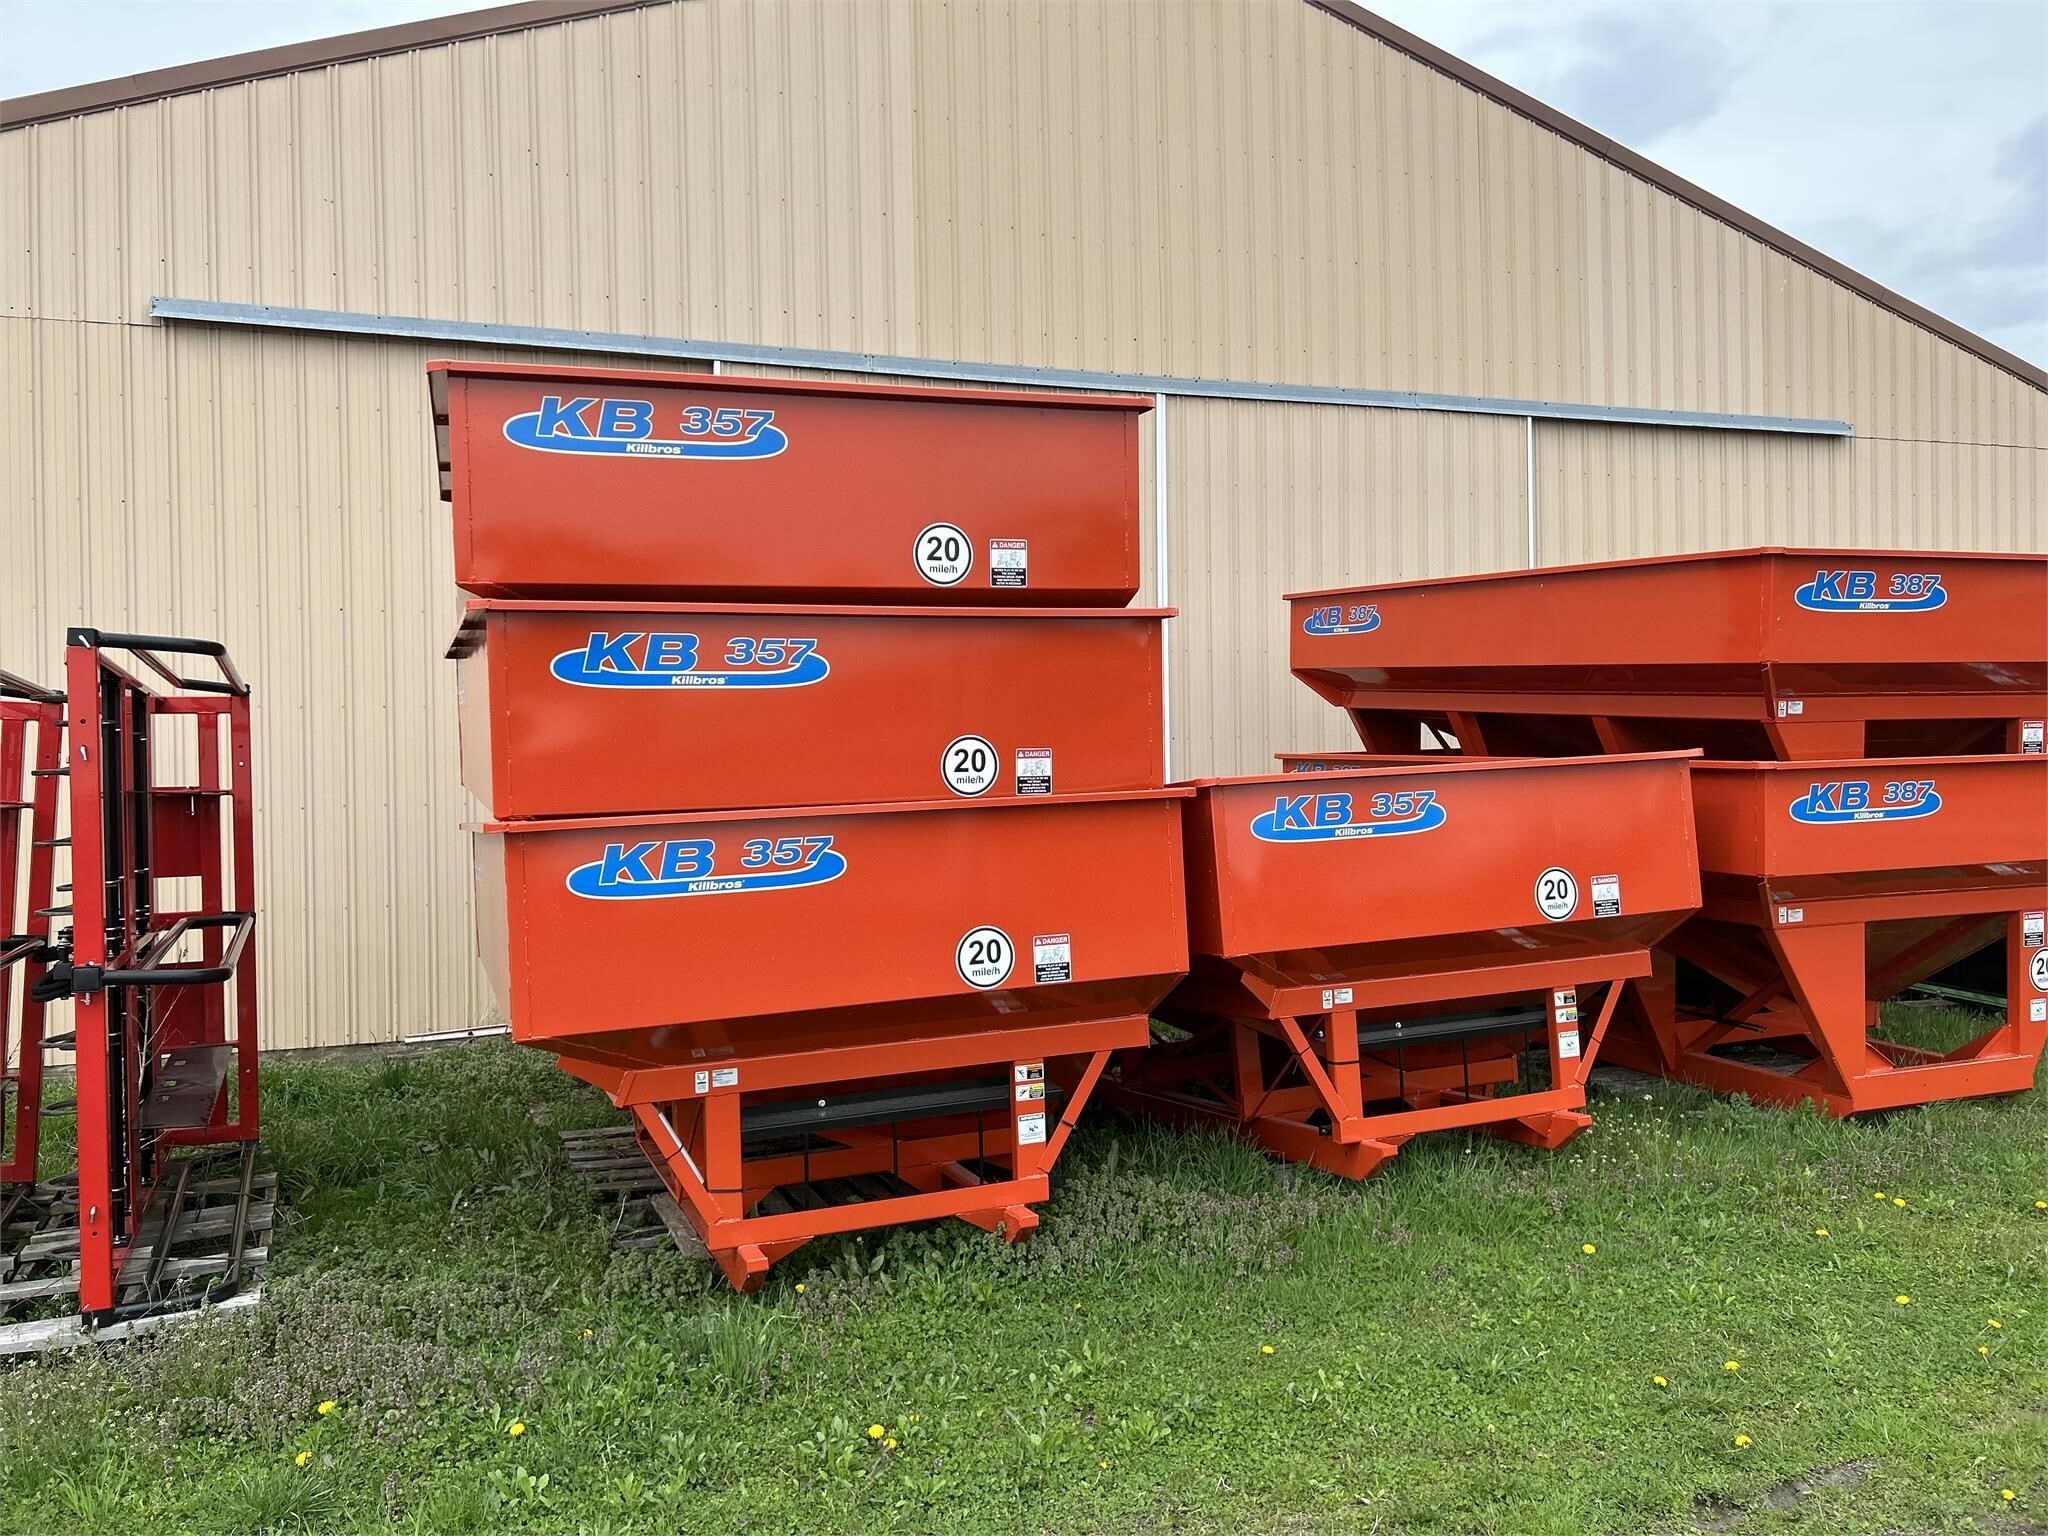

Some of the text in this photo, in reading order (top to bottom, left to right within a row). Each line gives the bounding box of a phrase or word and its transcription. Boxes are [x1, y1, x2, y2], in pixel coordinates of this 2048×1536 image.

[535, 396, 775, 439] KB 357
[626, 442, 682, 455] Killbros
[926, 536, 960, 562] 20
[999, 541, 1026, 549] DANGER
[929, 564, 958, 574] mile/h
[1811, 570, 1942, 601] KB 387
[1858, 602, 1890, 610] Killbros
[1310, 604, 1378, 629] KB 387
[582, 632, 818, 673] KB 357
[671, 675, 727, 686] Killbros
[953, 748, 987, 773] 20
[1024, 750, 1050, 758] DANGER
[956, 775, 985, 785] mile/h
[1805, 779, 1936, 814] KB 387
[1272, 789, 1436, 832] KB 357
[1853, 811, 1884, 820] Killbros
[1334, 826, 1374, 838] Killbros
[598, 835, 834, 886] KB 357
[687, 879, 744, 892] Killbros
[1543, 878, 1569, 901] 20
[1042, 936, 1068, 945] DANGER
[968, 938, 1002, 966] 20
[972, 966, 1001, 977] mile/h
